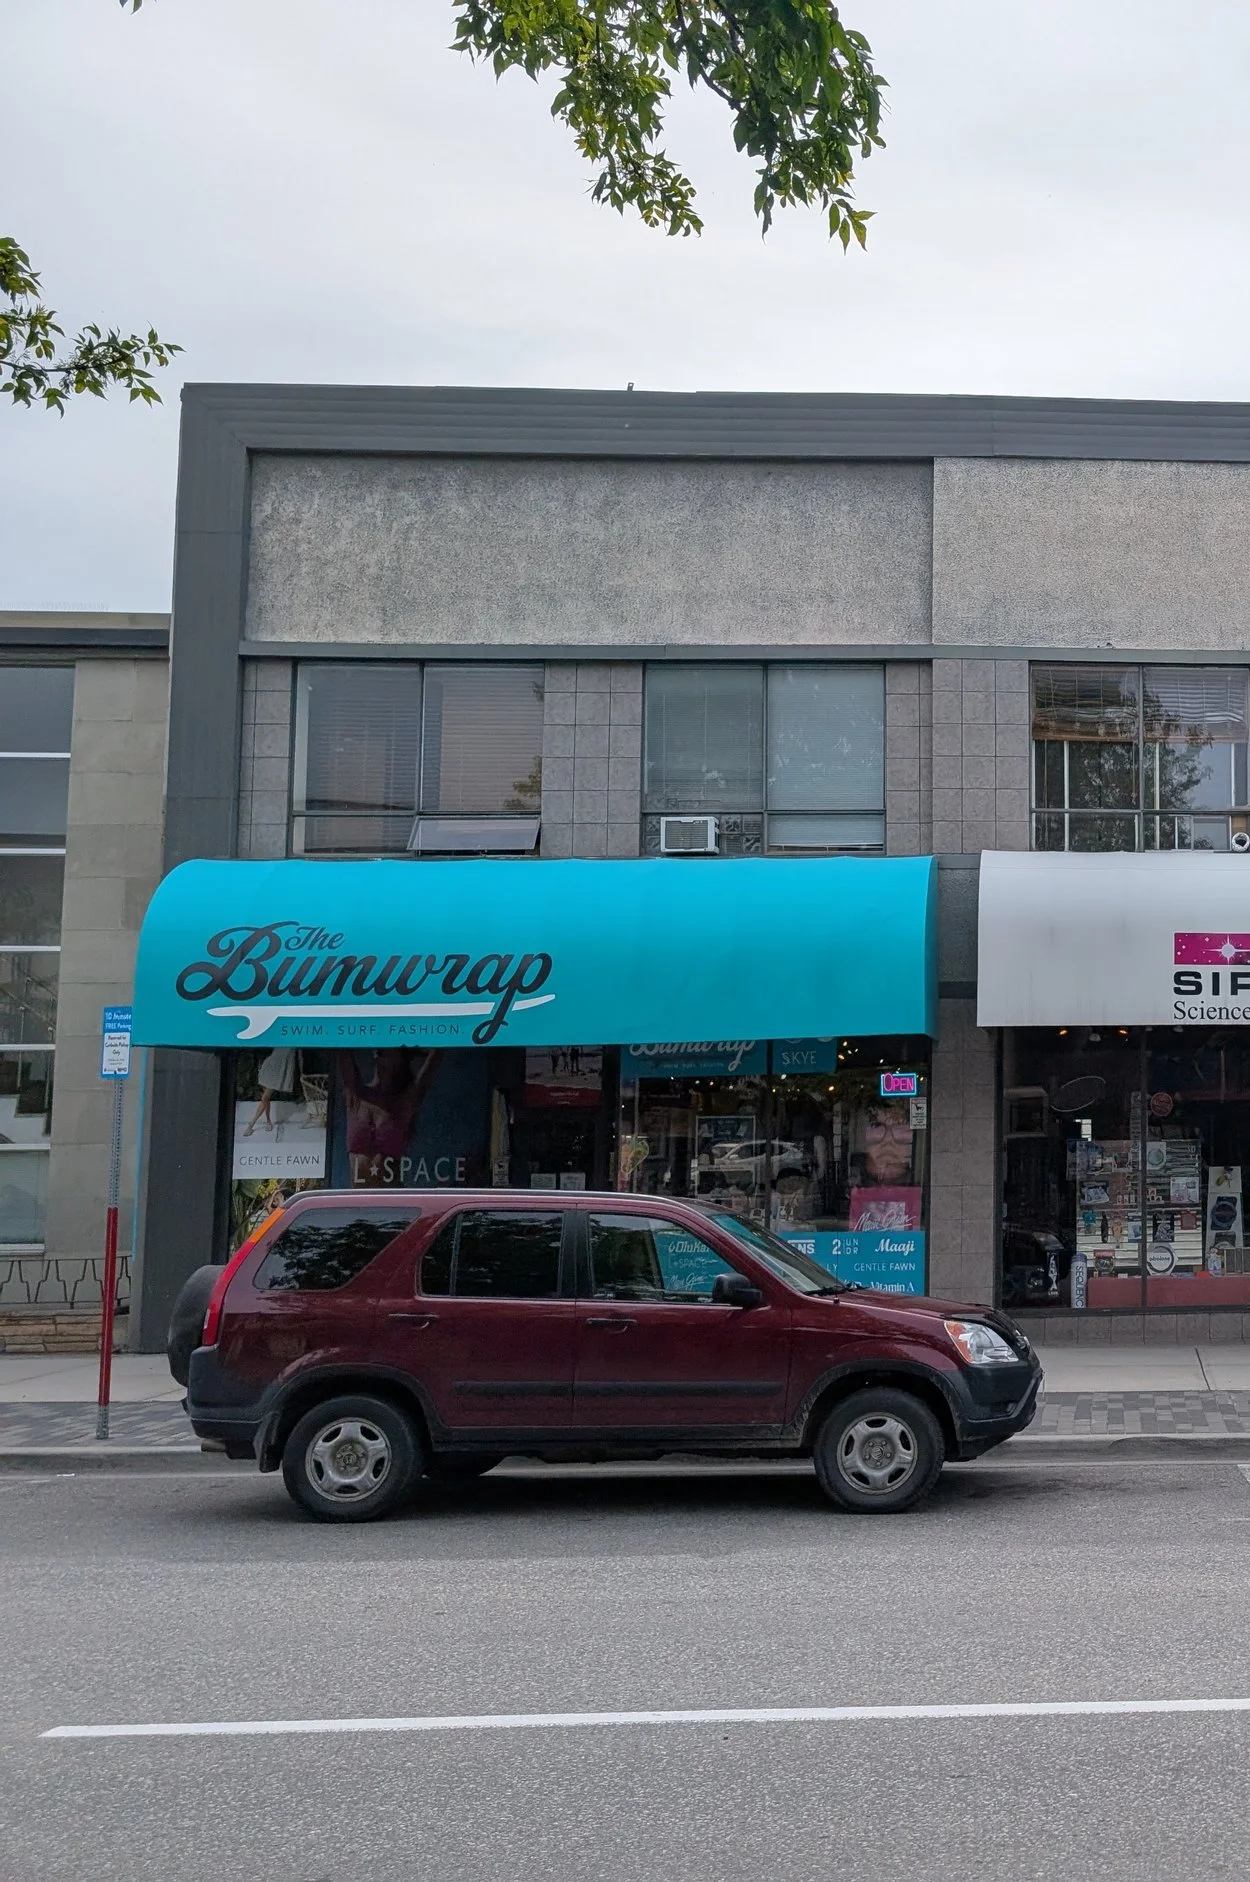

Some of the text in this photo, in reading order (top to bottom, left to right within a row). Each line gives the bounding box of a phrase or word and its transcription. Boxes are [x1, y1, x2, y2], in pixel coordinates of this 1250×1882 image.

[284, 925, 345, 951] The
[175, 921, 552, 1044] Bumwrap
[280, 1024, 329, 1036] SWIM.
[389, 1023, 465, 1035] FASHION.
[781, 1051, 817, 1065] SKYE
[884, 1073, 914, 1092] OPEN
[239, 1155, 320, 1166] GENTLE FAWN
[383, 1156, 467, 1182] SPACE
[875, 1239, 916, 1256] Maaji
[853, 1263, 916, 1271] GENTLE FAWN
[906, 1281, 915, 1292] A
[1076, 1265, 1085, 1307] SEQUENC
